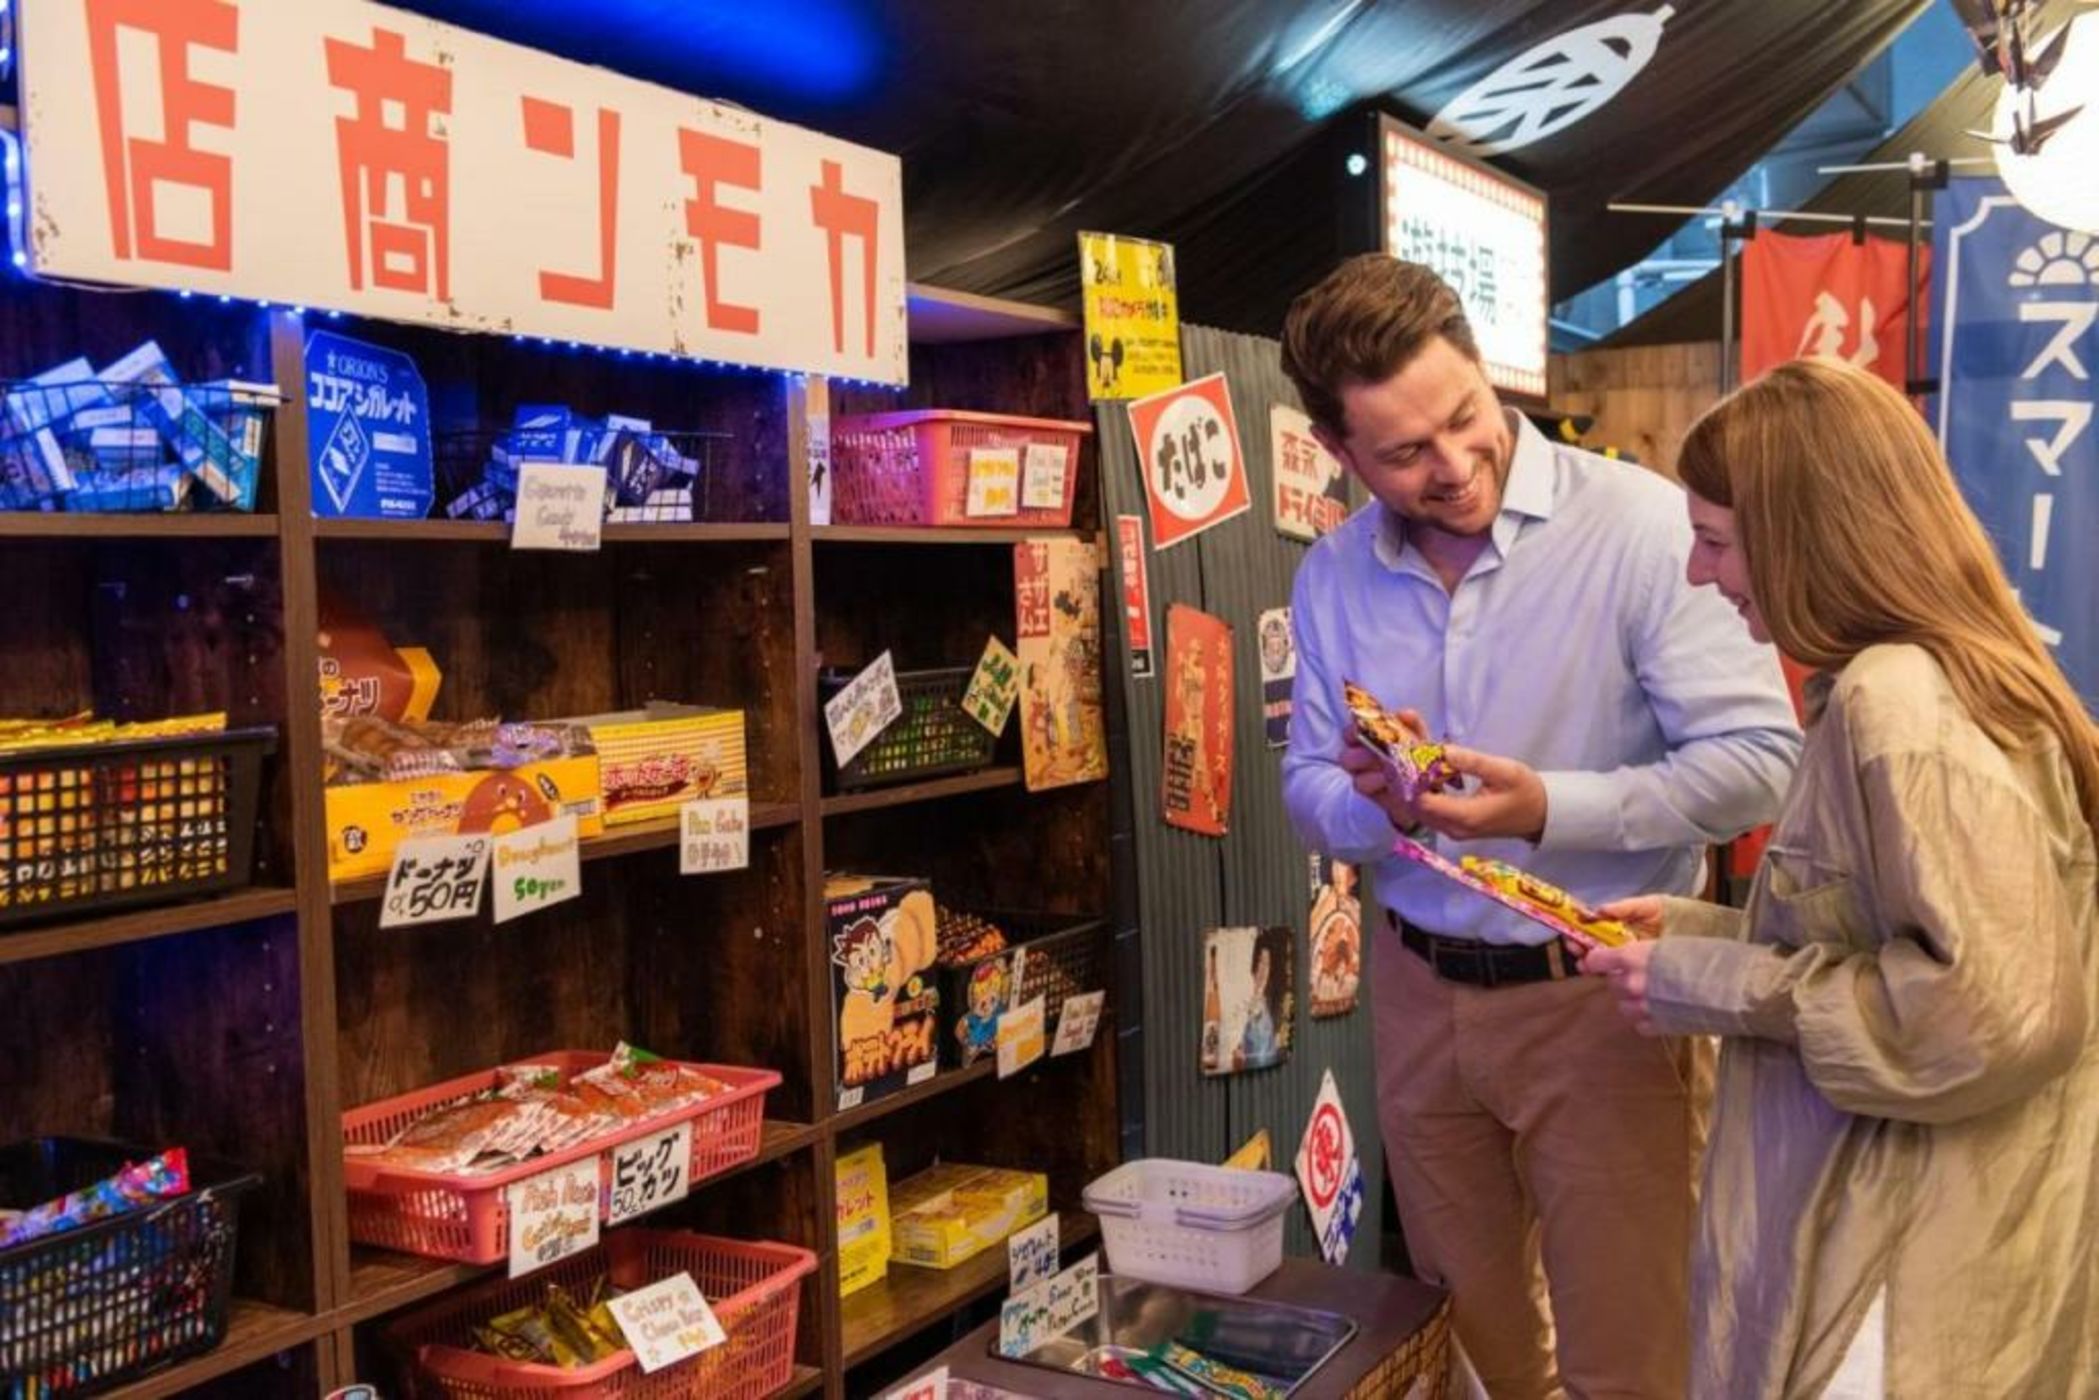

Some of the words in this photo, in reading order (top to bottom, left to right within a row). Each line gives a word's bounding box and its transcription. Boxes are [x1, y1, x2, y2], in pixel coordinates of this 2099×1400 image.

[1157, 418, 1226, 500] たばこ
[2009, 303, 2098, 647] スマー
[393, 856, 475, 888] ドーナツ
[409, 879, 477, 917] 50円
[616, 1131, 680, 1188] ビッグ
[638, 1166, 681, 1202] カツ
